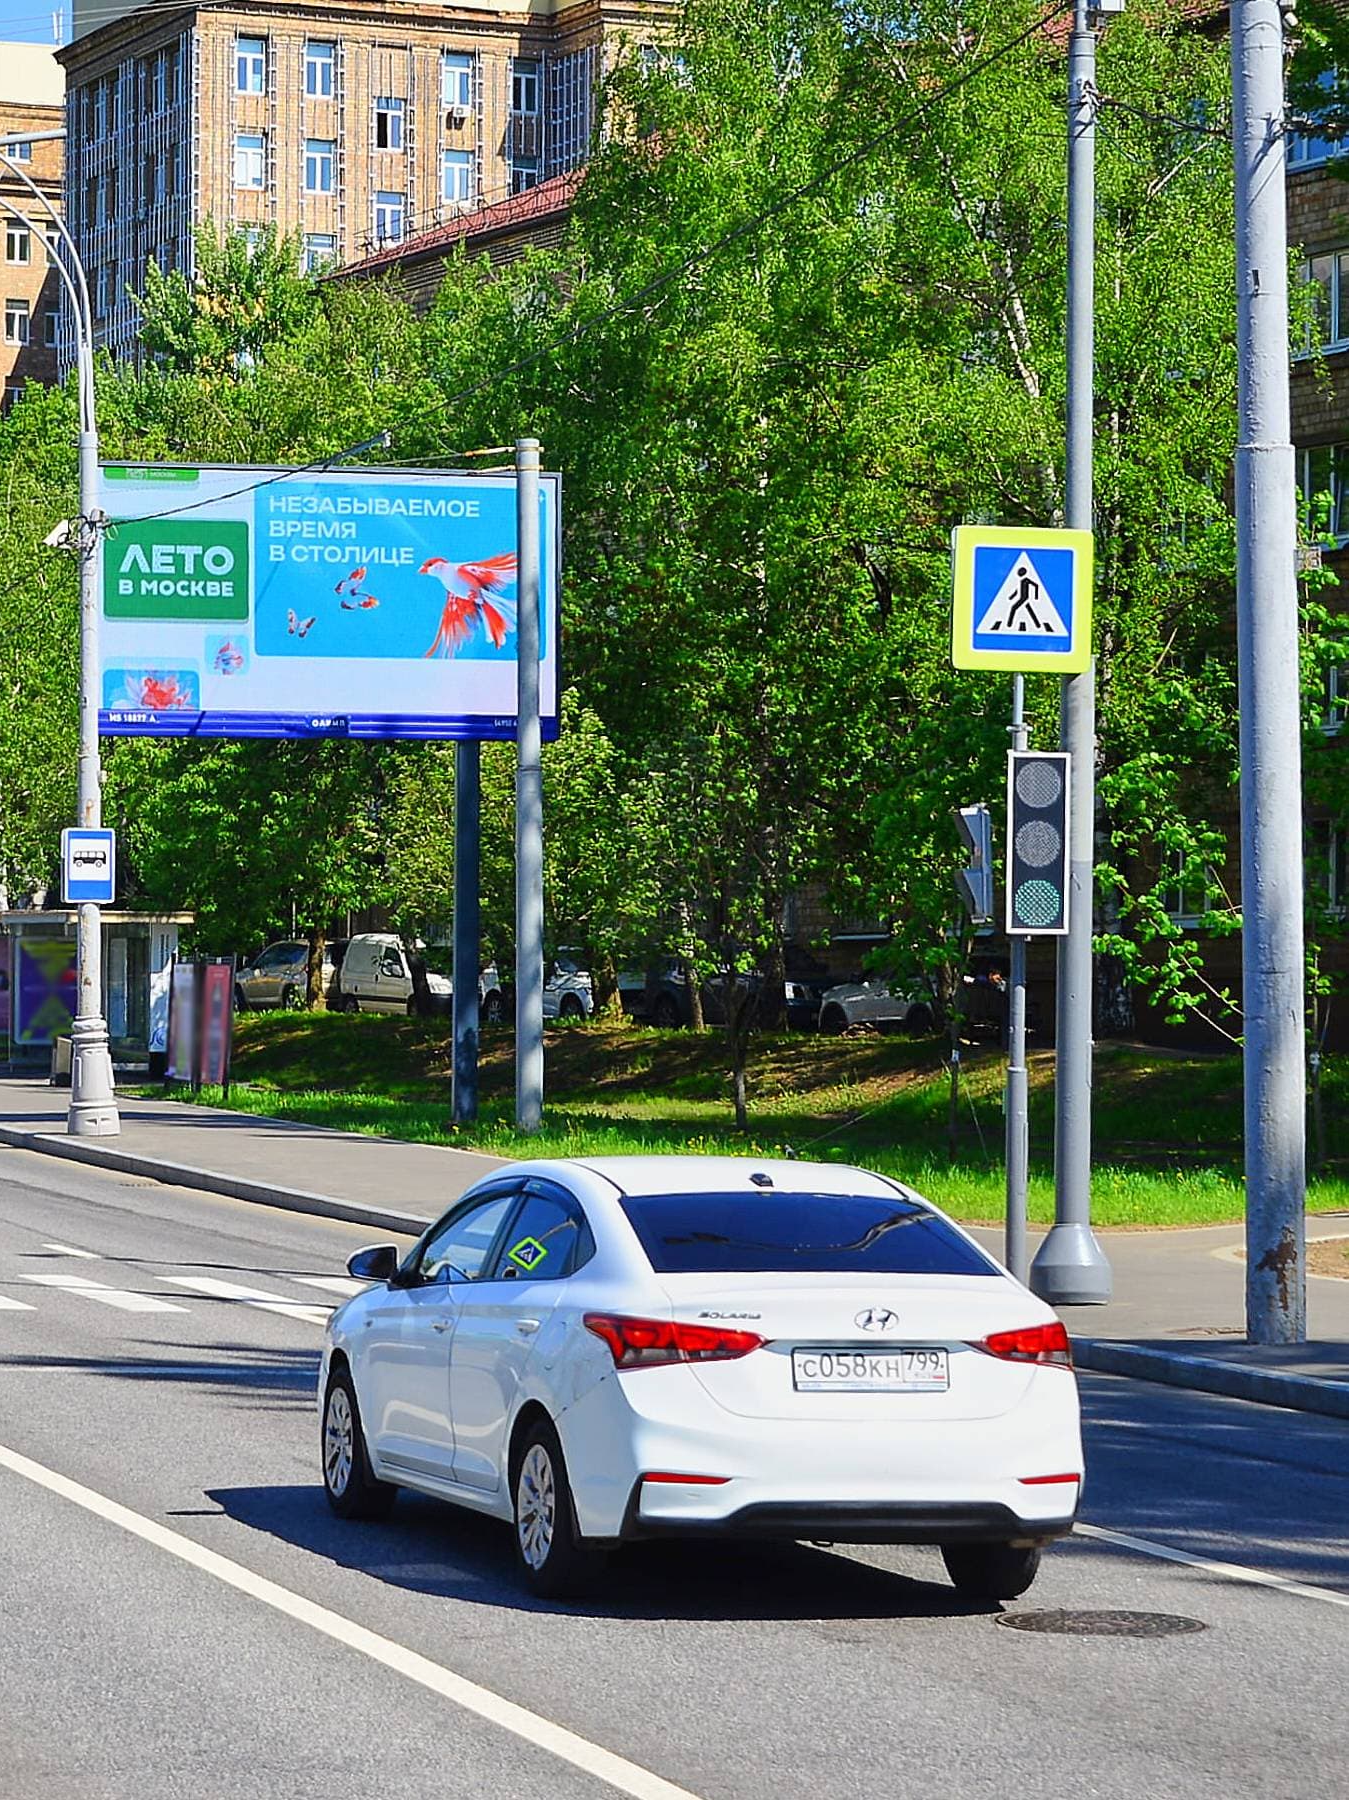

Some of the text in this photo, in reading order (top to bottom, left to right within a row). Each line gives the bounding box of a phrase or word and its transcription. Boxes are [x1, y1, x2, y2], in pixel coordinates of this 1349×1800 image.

[269, 495, 480, 519] НЕЗАБЫВАЕМОЕ
[269, 520, 357, 540] ВРЕМЯ
[118, 543, 235, 576] ЛЕТО
[269, 545, 415, 566] В СТОЛИЦЕ
[118, 579, 235, 598] В МОСКВЕ
[802, 1351, 940, 1379] С058КН 799
